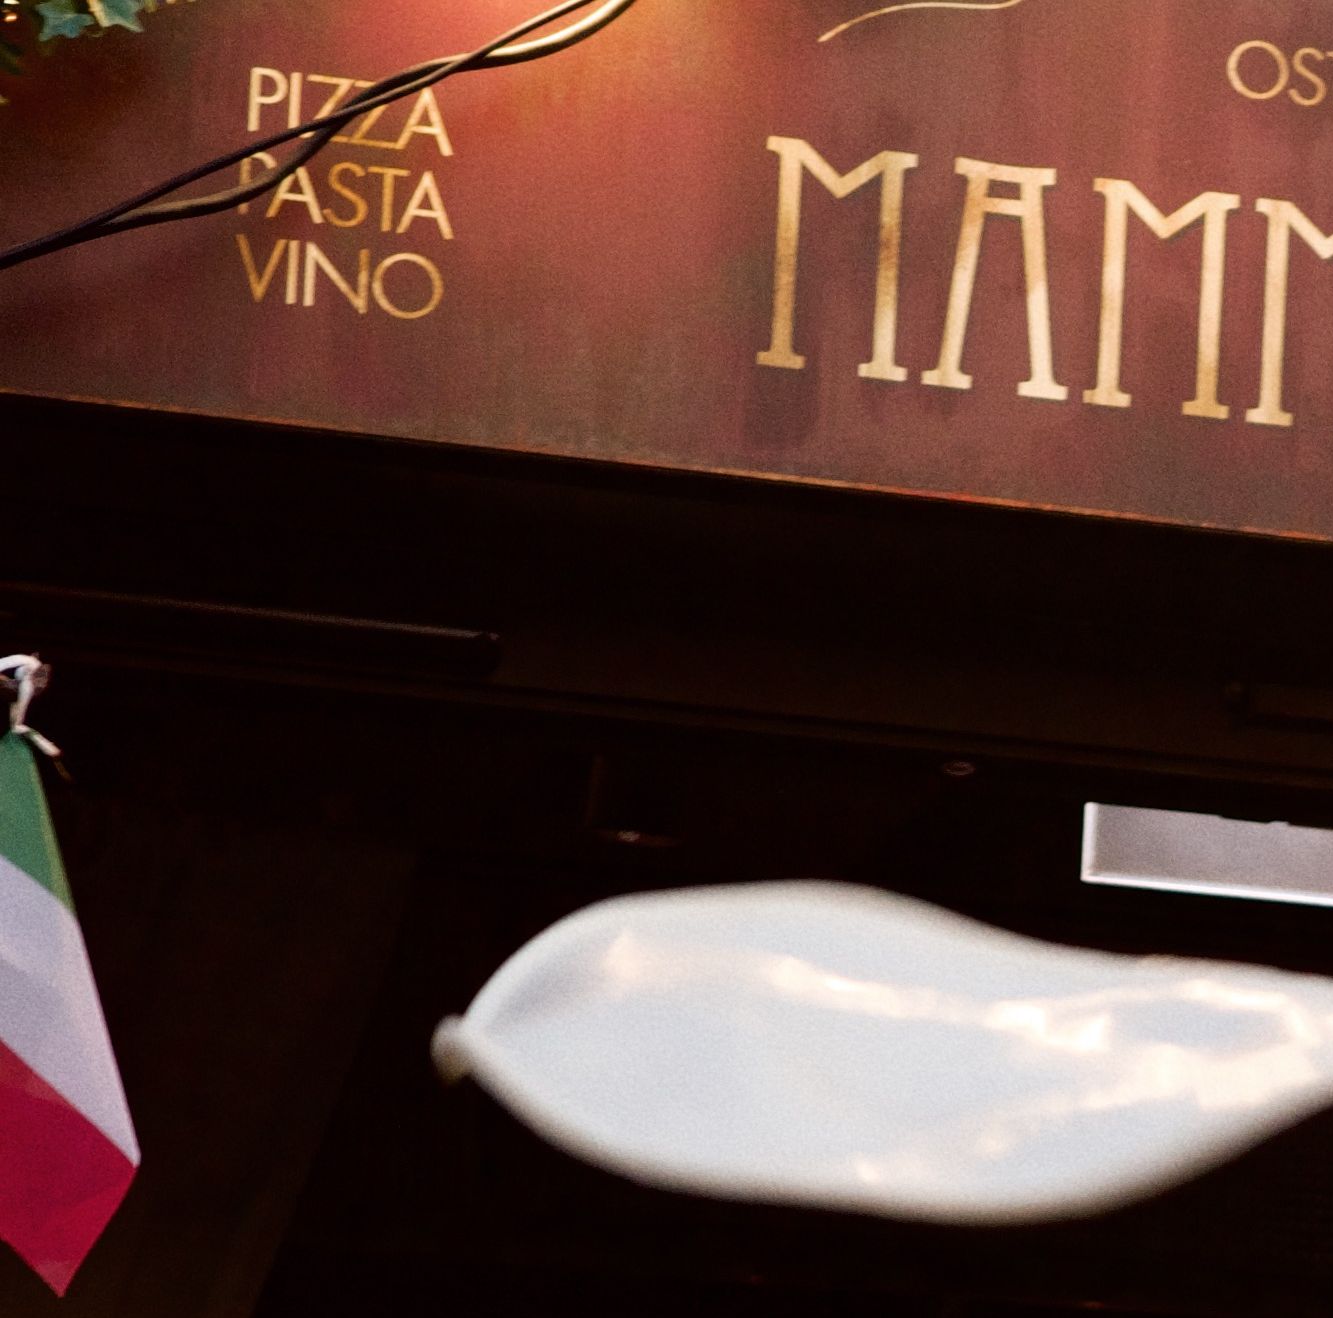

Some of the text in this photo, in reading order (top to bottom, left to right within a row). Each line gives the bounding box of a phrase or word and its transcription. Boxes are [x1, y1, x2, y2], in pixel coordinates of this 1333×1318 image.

[247, 66, 454, 157] PIZZA
[236, 151, 455, 240] PASTA
[235, 233, 445, 320] VINO
